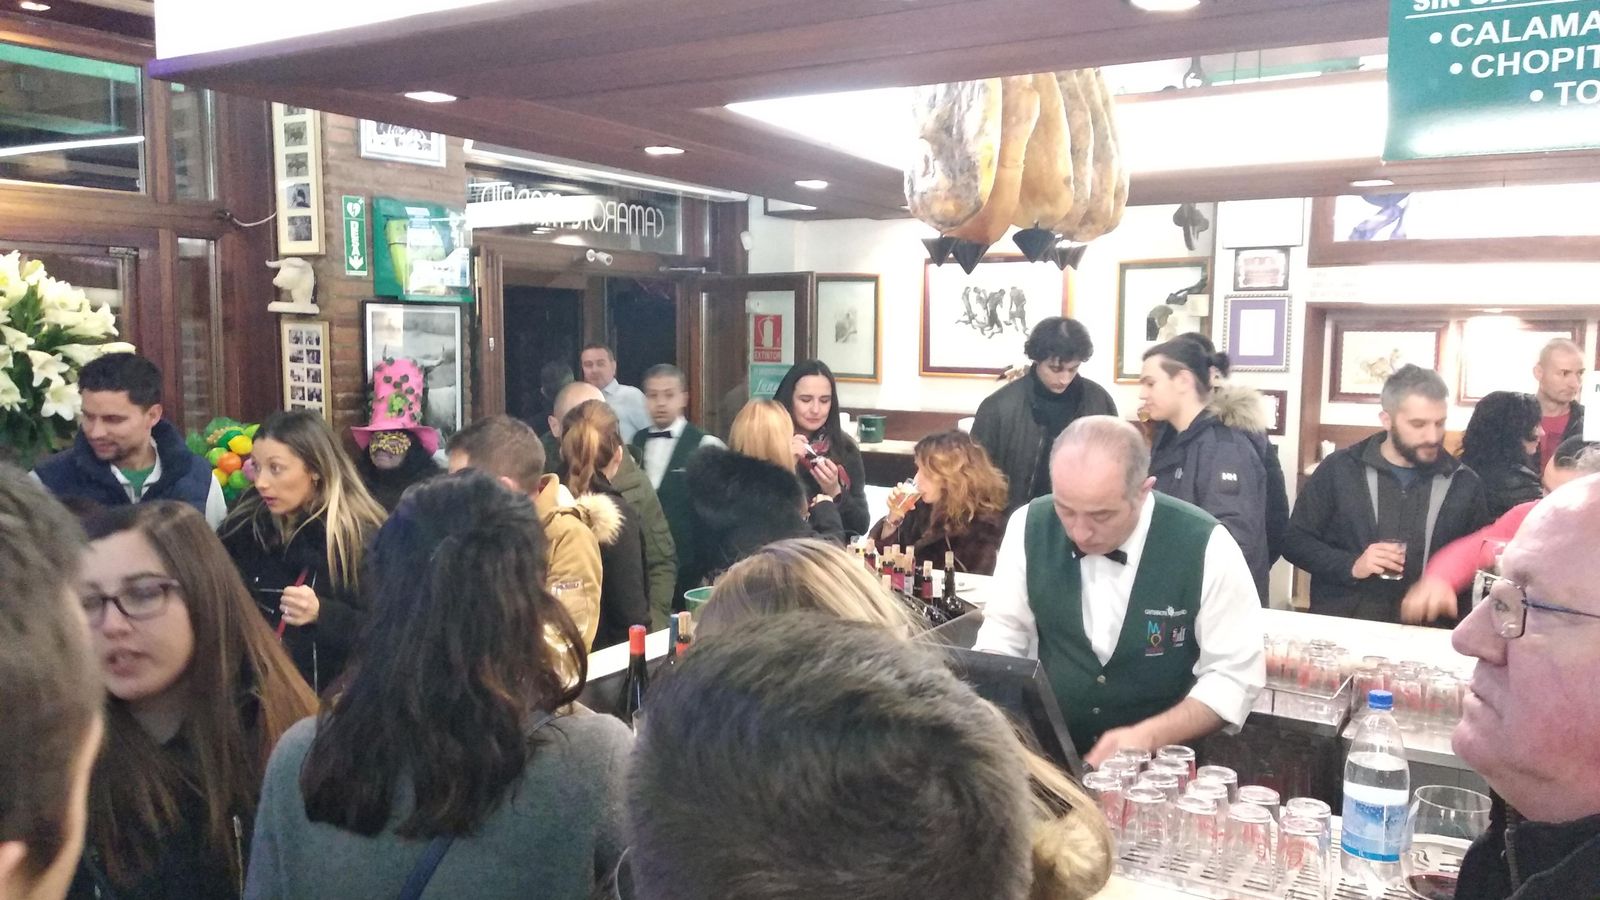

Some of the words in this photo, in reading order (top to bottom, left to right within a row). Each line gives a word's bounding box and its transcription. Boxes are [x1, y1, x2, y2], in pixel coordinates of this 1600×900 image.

[1450, 10, 1600, 47] CALAMA
[1554, 79, 1600, 106] TO
[753, 351, 782, 360] EXTINTOR
